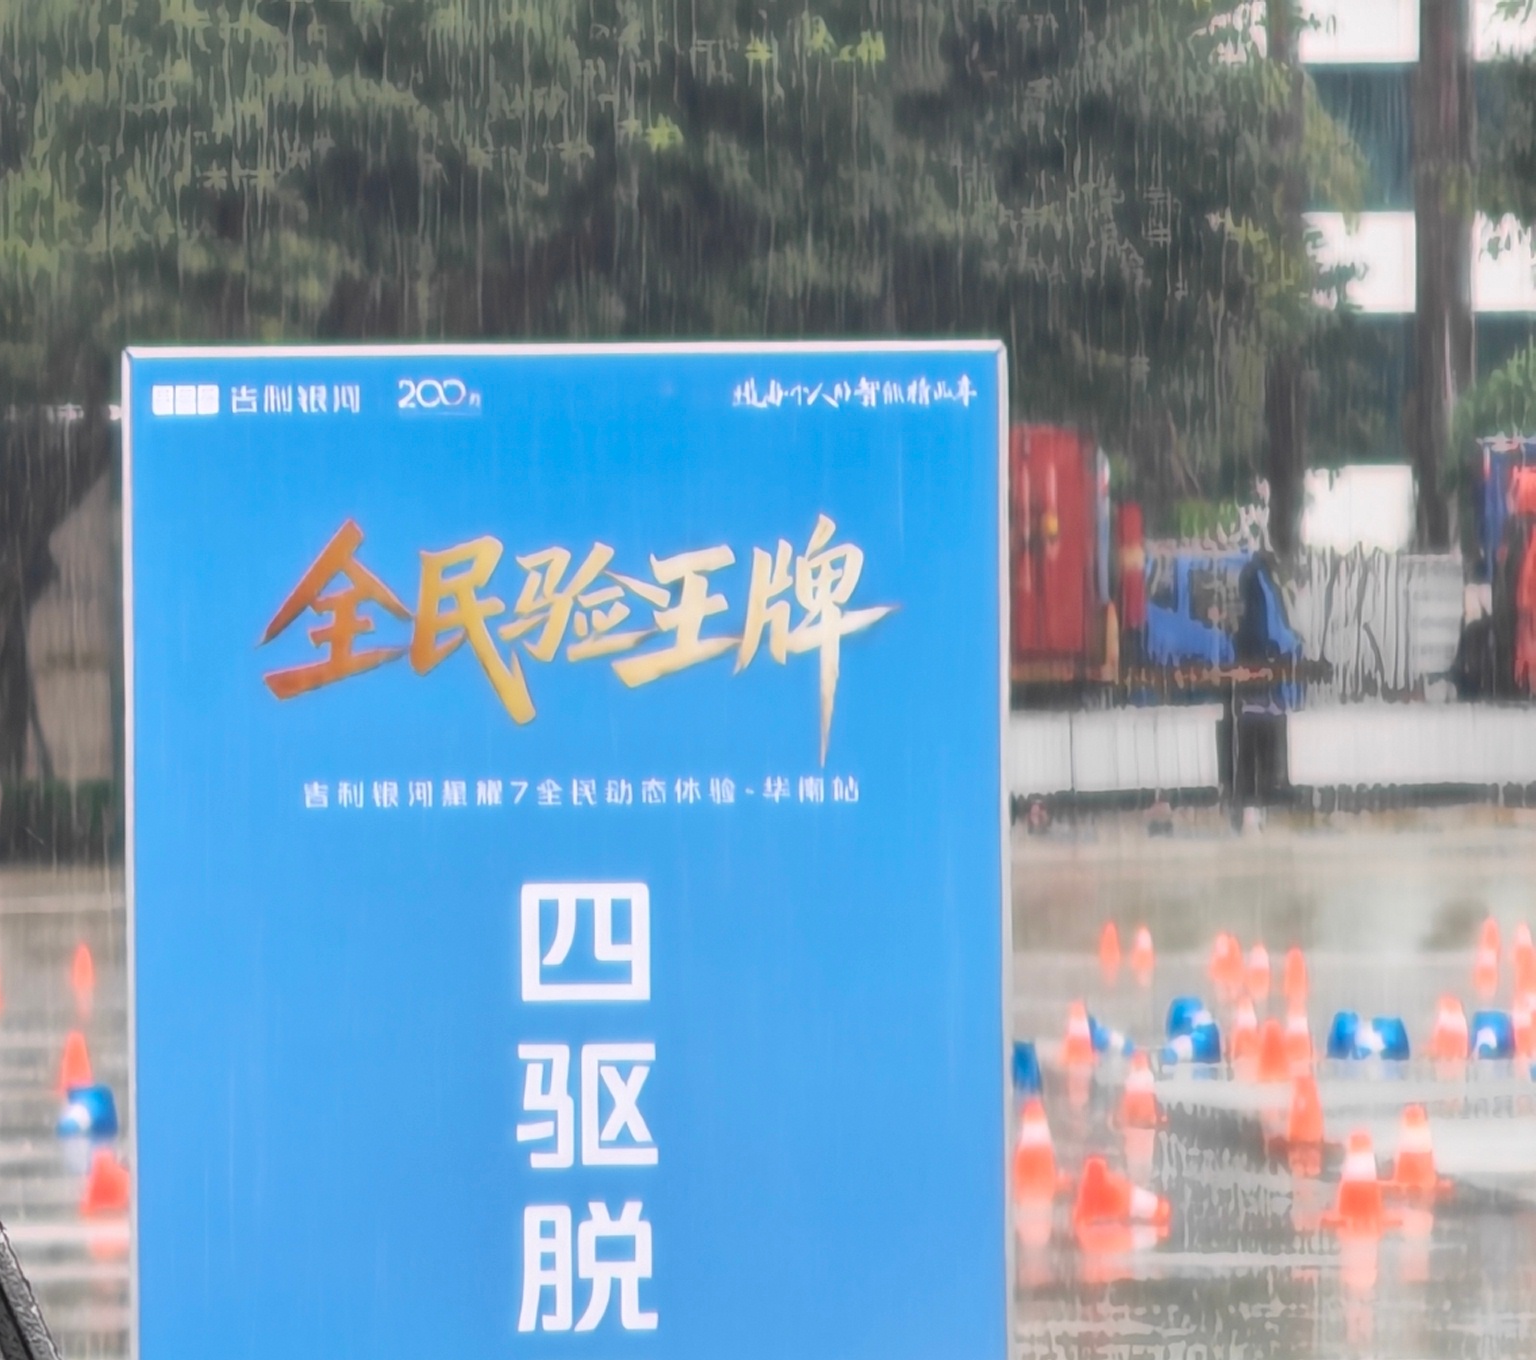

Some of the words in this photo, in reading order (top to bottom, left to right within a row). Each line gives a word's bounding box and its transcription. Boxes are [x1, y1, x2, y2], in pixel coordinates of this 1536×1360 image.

[231, 384, 361, 414] 吉利银河
[257, 514, 898, 768] 全民验王牌
